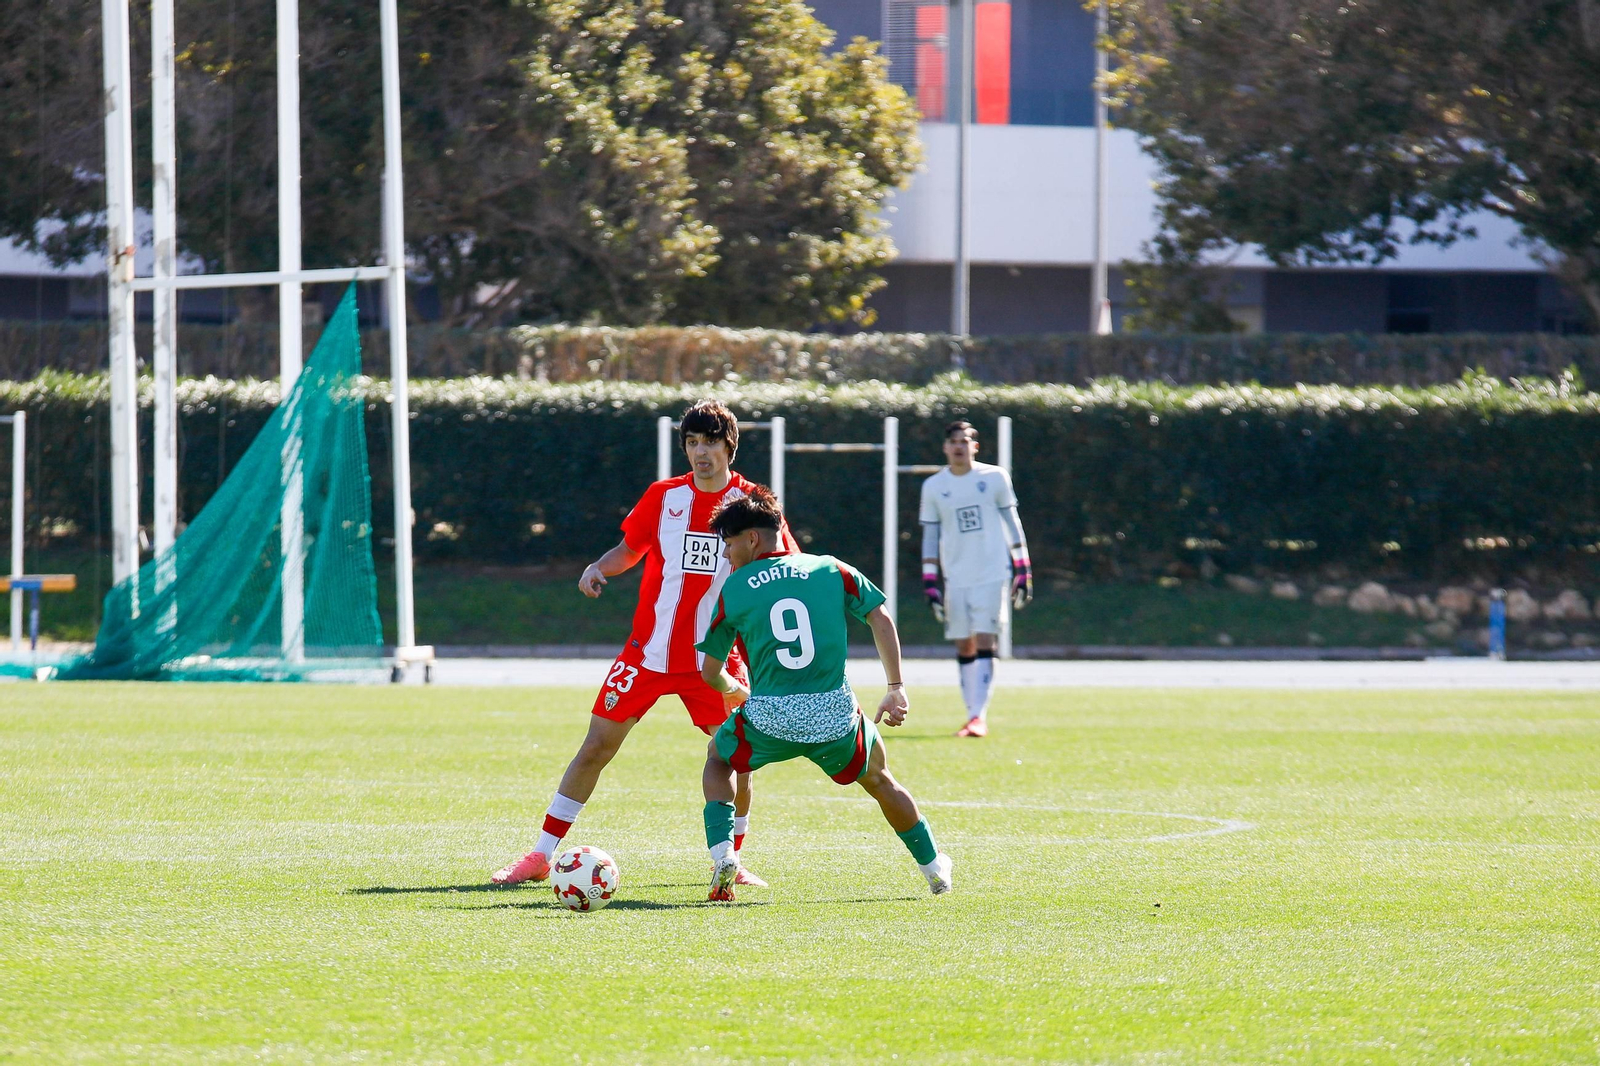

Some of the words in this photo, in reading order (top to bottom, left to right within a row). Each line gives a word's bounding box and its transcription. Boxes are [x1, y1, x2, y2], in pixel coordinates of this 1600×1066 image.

[692, 540, 710, 553] DA
[691, 554, 709, 566] ZN
[769, 598, 815, 669] 9
[606, 661, 638, 692] 23
